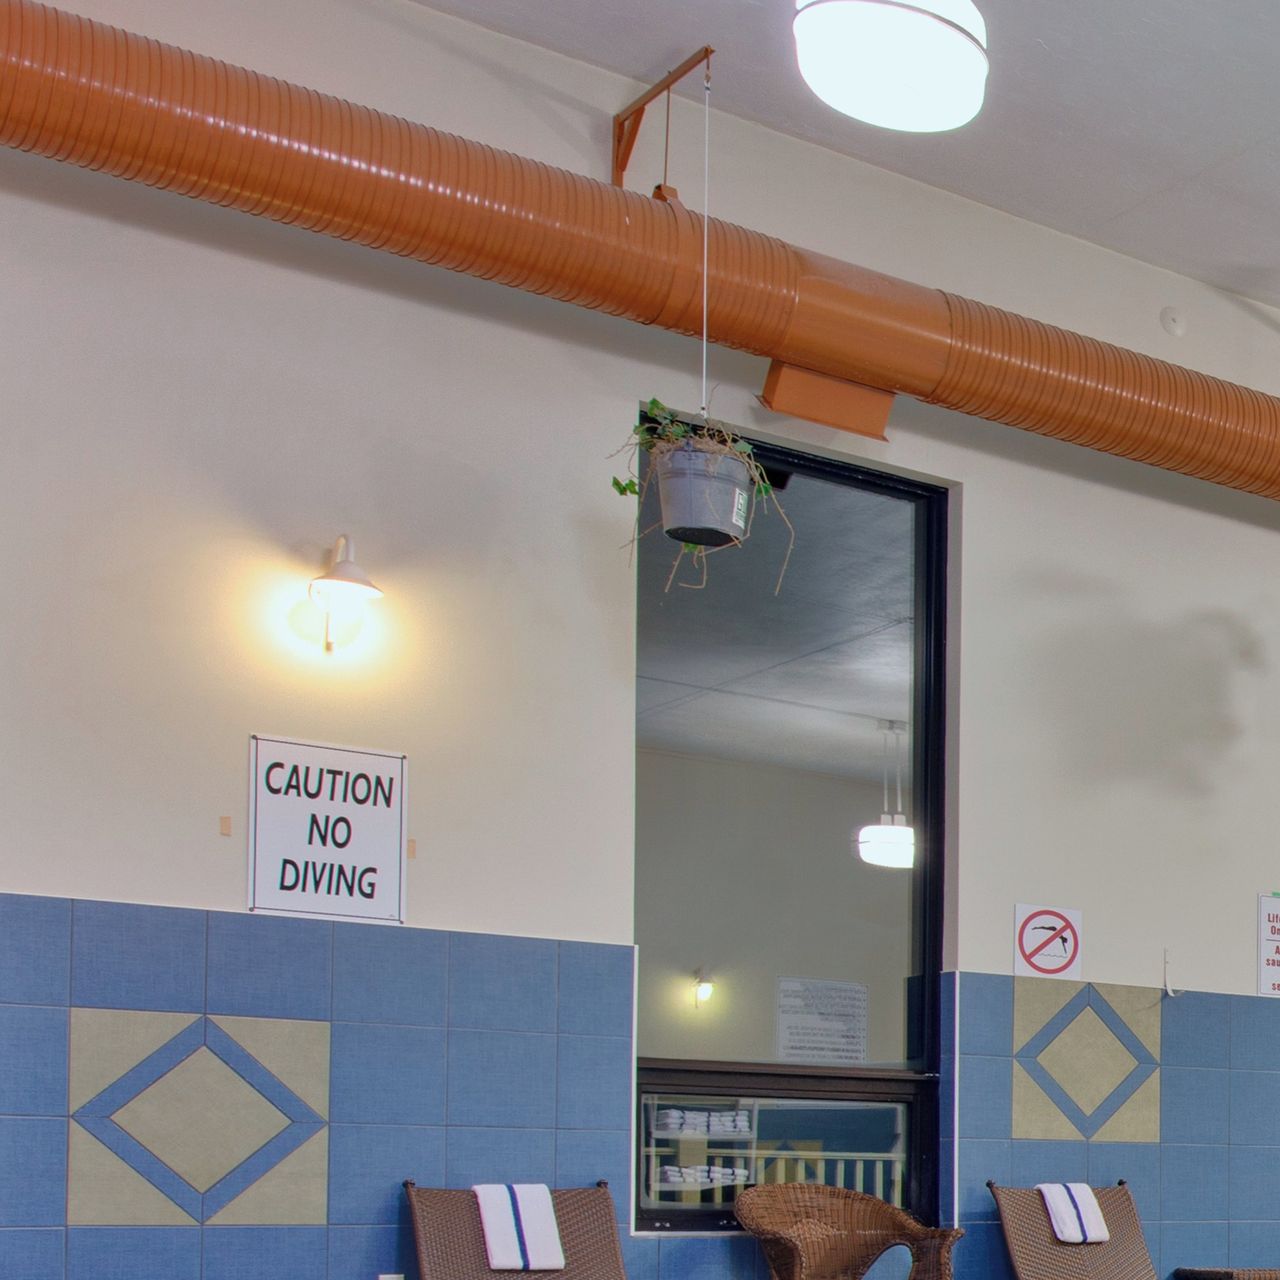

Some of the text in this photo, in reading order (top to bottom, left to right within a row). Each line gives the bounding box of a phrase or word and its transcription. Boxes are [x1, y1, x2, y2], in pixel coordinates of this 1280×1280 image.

[265, 762, 394, 808] CAUTION
[308, 813, 352, 849] NO
[279, 858, 378, 899] DIVING
